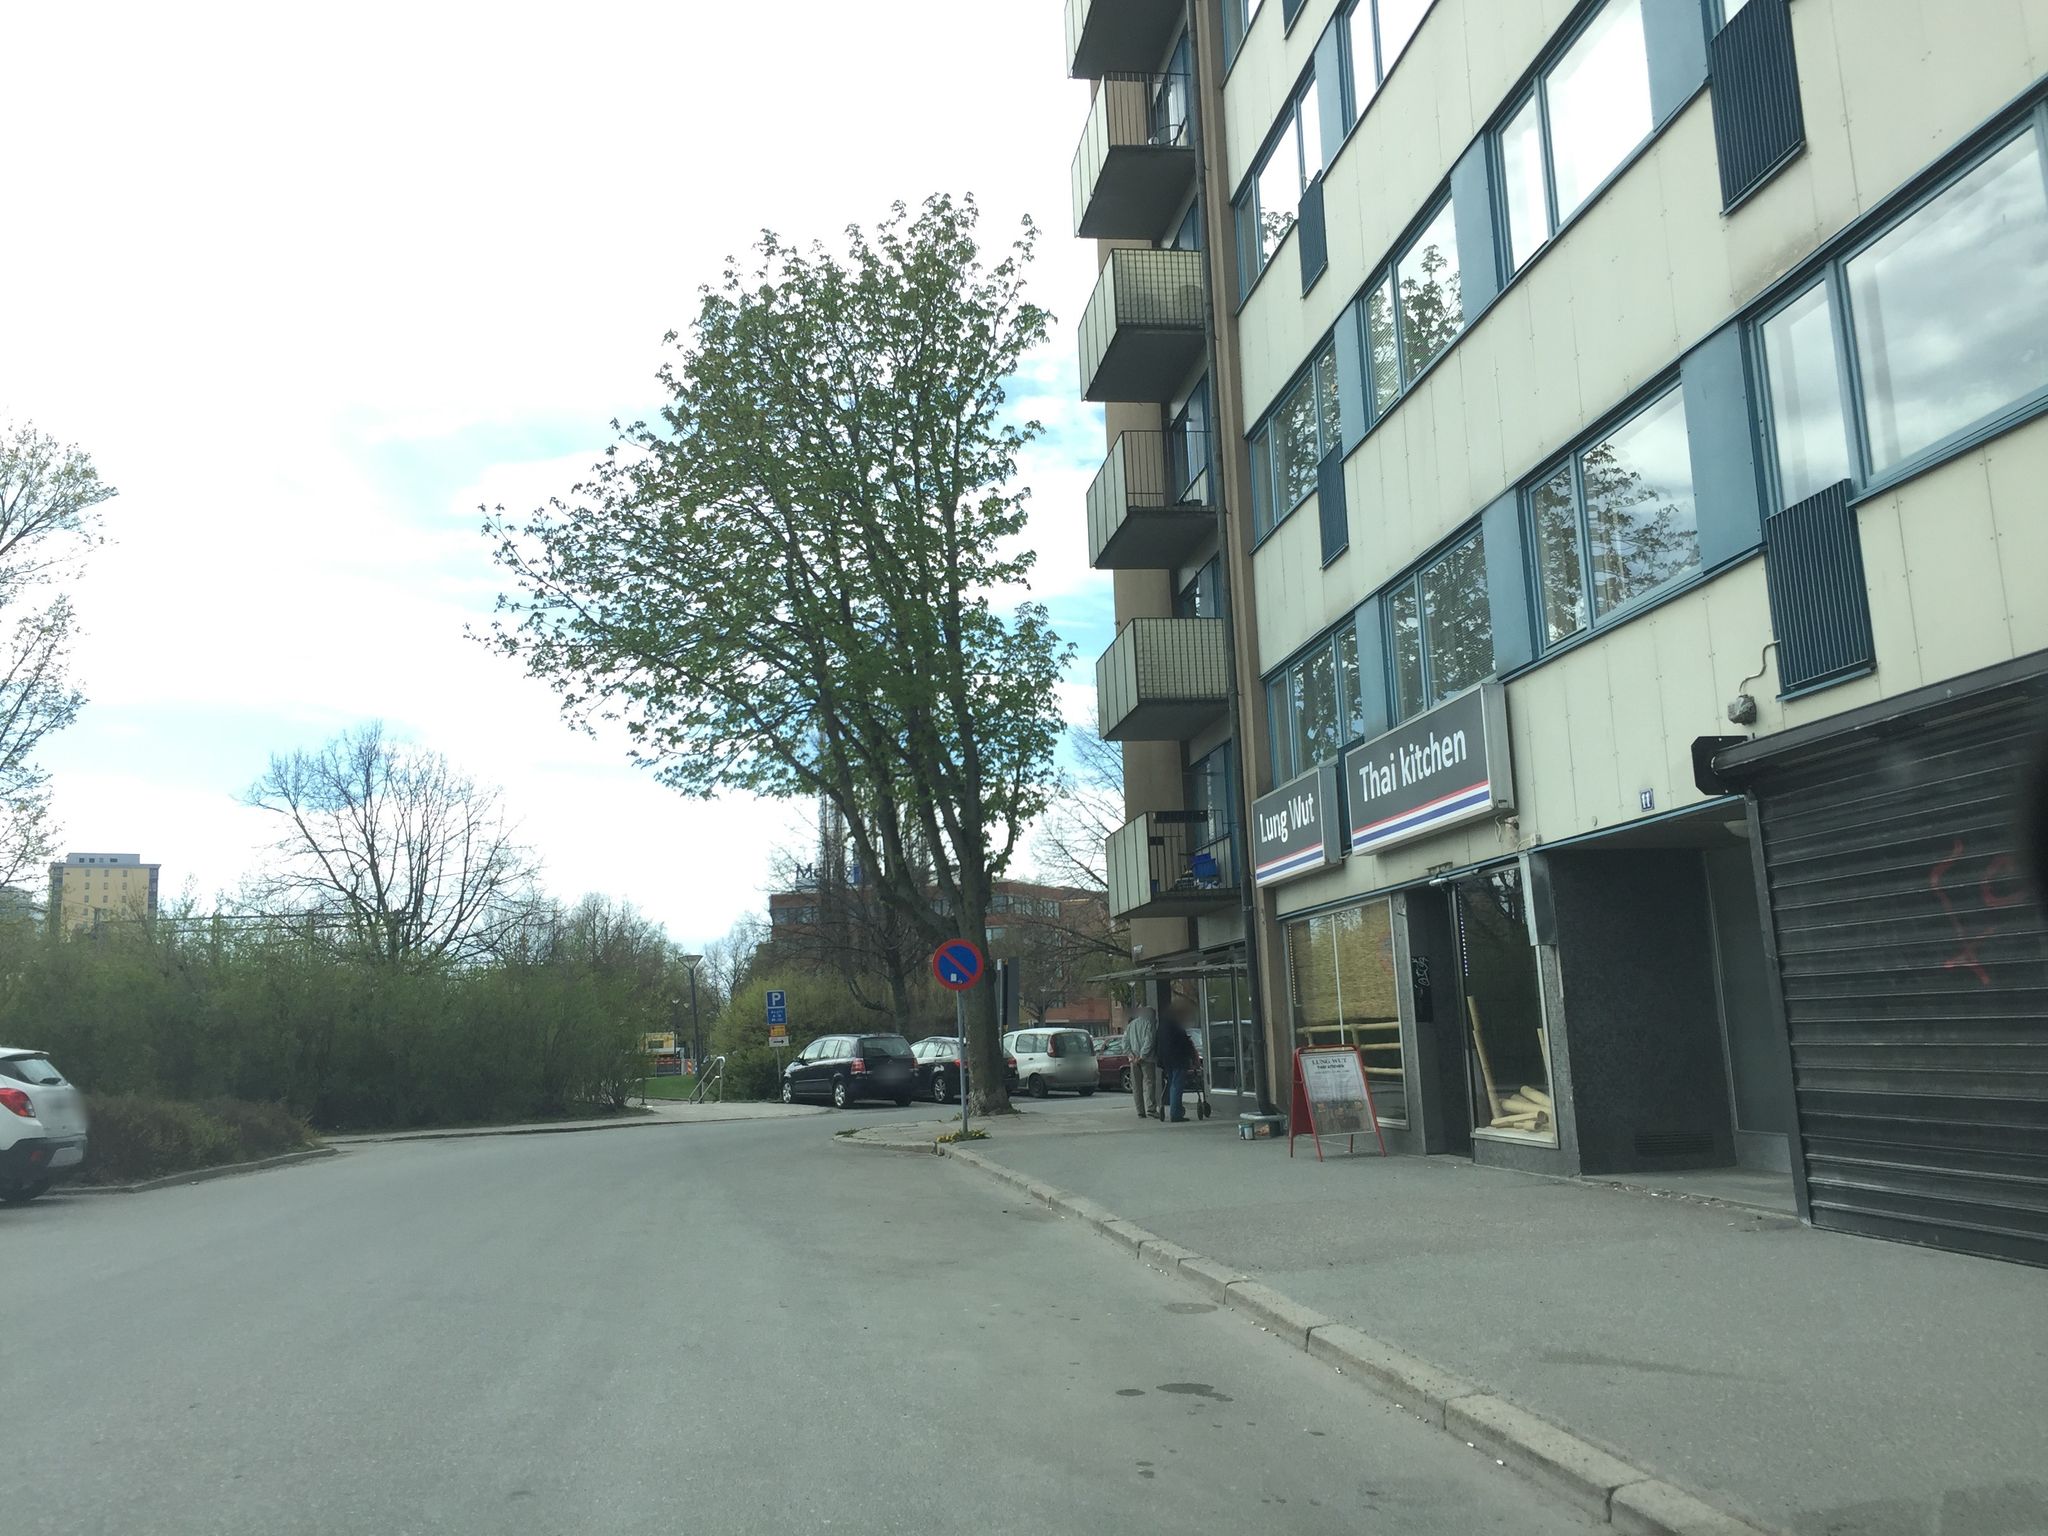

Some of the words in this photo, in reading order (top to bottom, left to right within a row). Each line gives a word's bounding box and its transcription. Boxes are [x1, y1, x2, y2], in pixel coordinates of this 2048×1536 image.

[1359, 752, 1397, 802] Thai
[1399, 730, 1467, 787] kitchen
[1641, 792, 1651, 809] 11
[1260, 810, 1289, 843] Lung
[1288, 793, 1315, 831] Wut
[772, 992, 781, 1006] P
